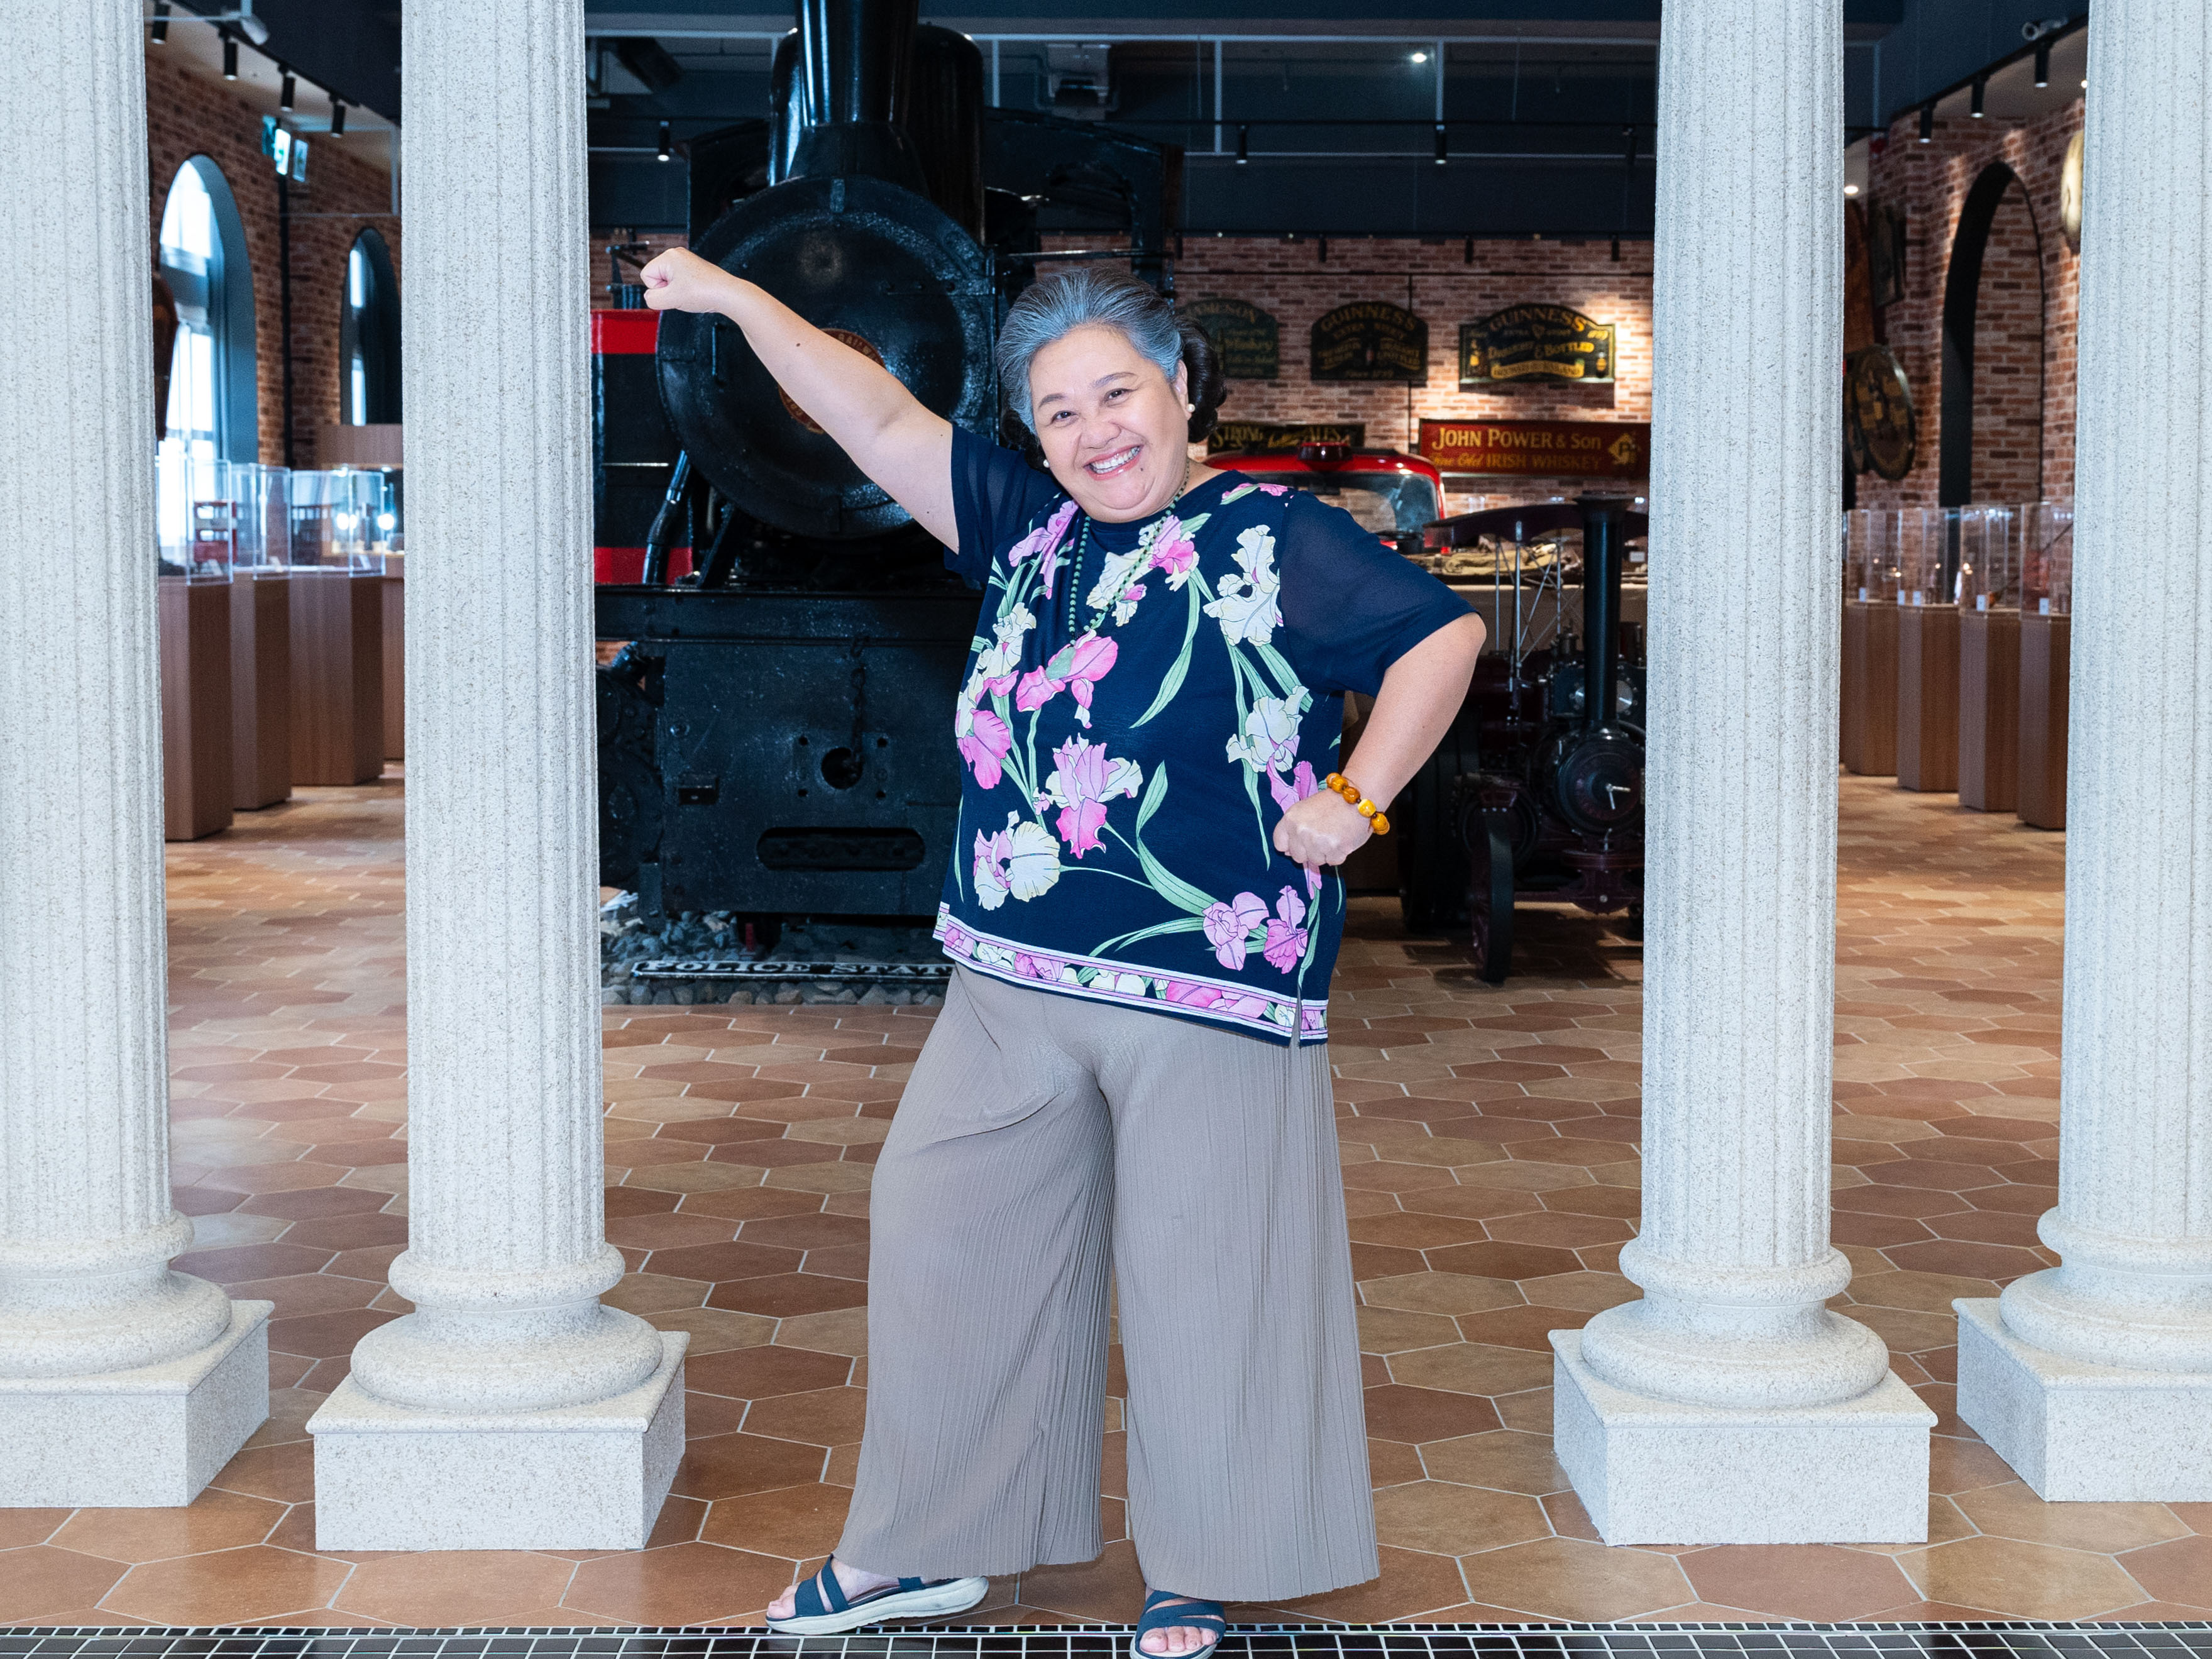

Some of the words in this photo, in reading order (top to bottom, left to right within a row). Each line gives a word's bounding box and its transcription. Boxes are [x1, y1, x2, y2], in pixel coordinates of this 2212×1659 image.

[1321, 304, 1417, 332] GUINNESS
[1490, 307, 1585, 332] GUINNESS
[1213, 426, 1263, 448] STRONG
[1431, 427, 1482, 451] JOHN
[1488, 428, 1553, 448] POWER
[1556, 435, 1566, 448] &
[1571, 433, 1602, 449] Son
[1486, 453, 1527, 468] IRISH
[1532, 454, 1601, 470] WHISKEY
[645, 960, 811, 973] POLICE
[830, 962, 954, 975] STAT
